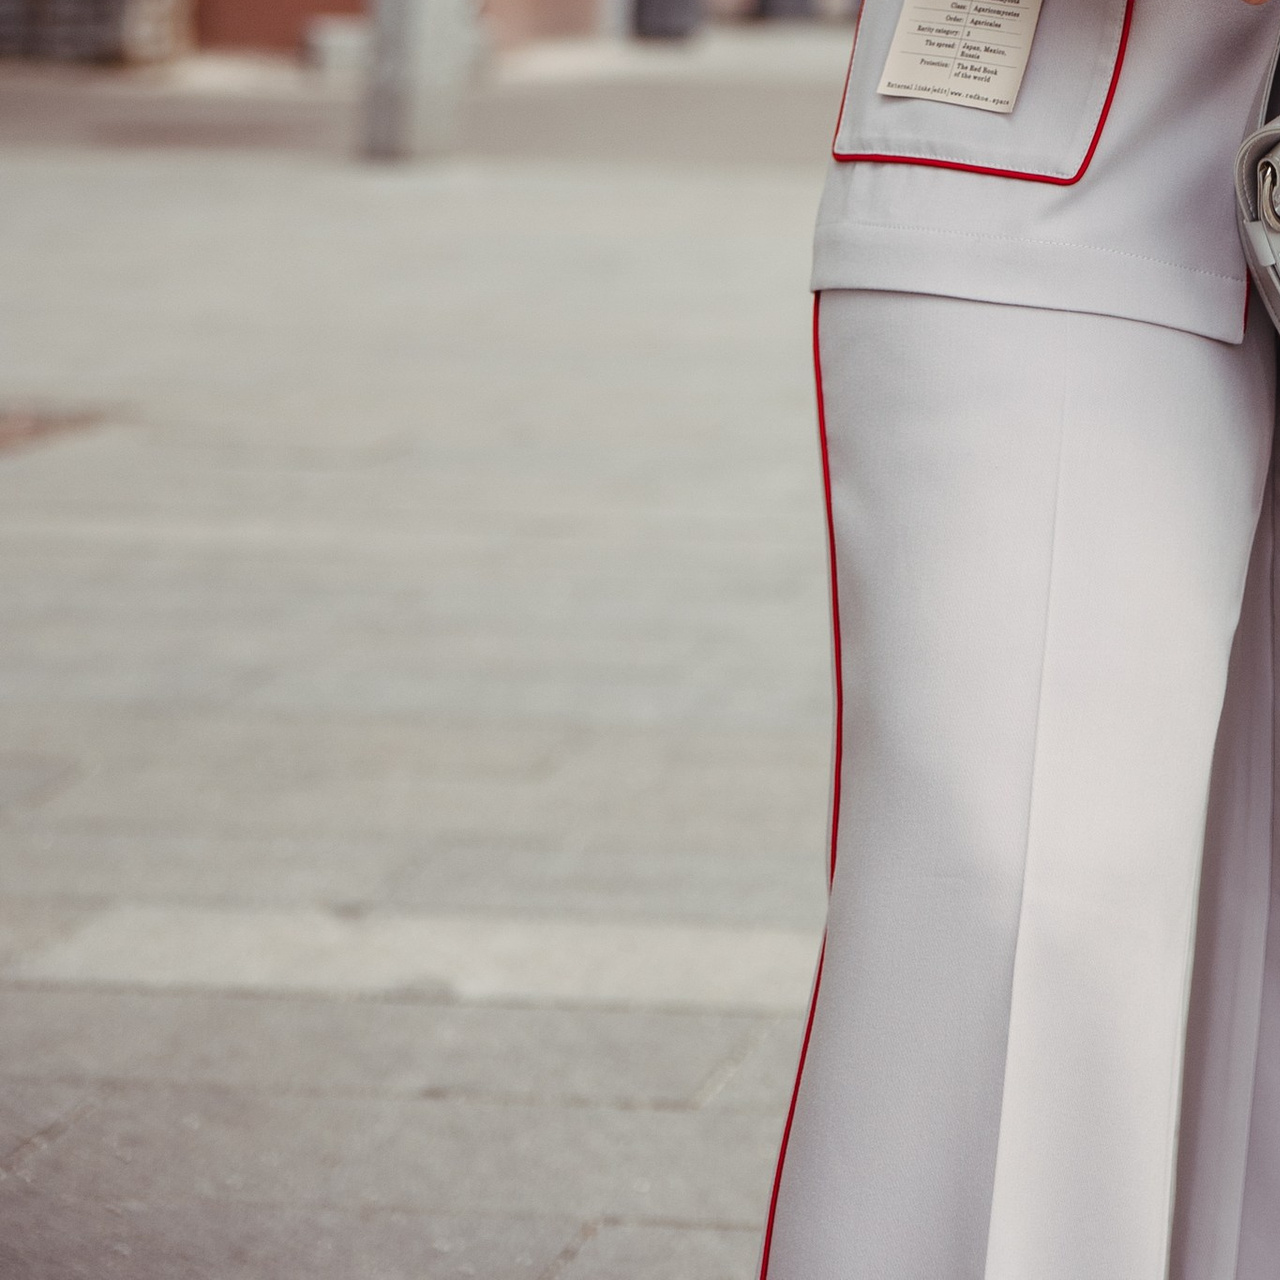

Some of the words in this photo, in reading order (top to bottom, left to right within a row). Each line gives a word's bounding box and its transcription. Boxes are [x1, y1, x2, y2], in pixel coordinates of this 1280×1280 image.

[973, 5, 1020, 18] Agaricomycetes
[969, 18, 1002, 28] Agaricales
[962, 43, 982, 52] Japan,
[984, 46, 1007, 56] Mexico,
[960, 52, 980, 60] Russia
[969, 65, 982, 73] Red
[982, 67, 998, 76] Book
[973, 75, 991, 83] world
[887, 81, 913, 90] External
